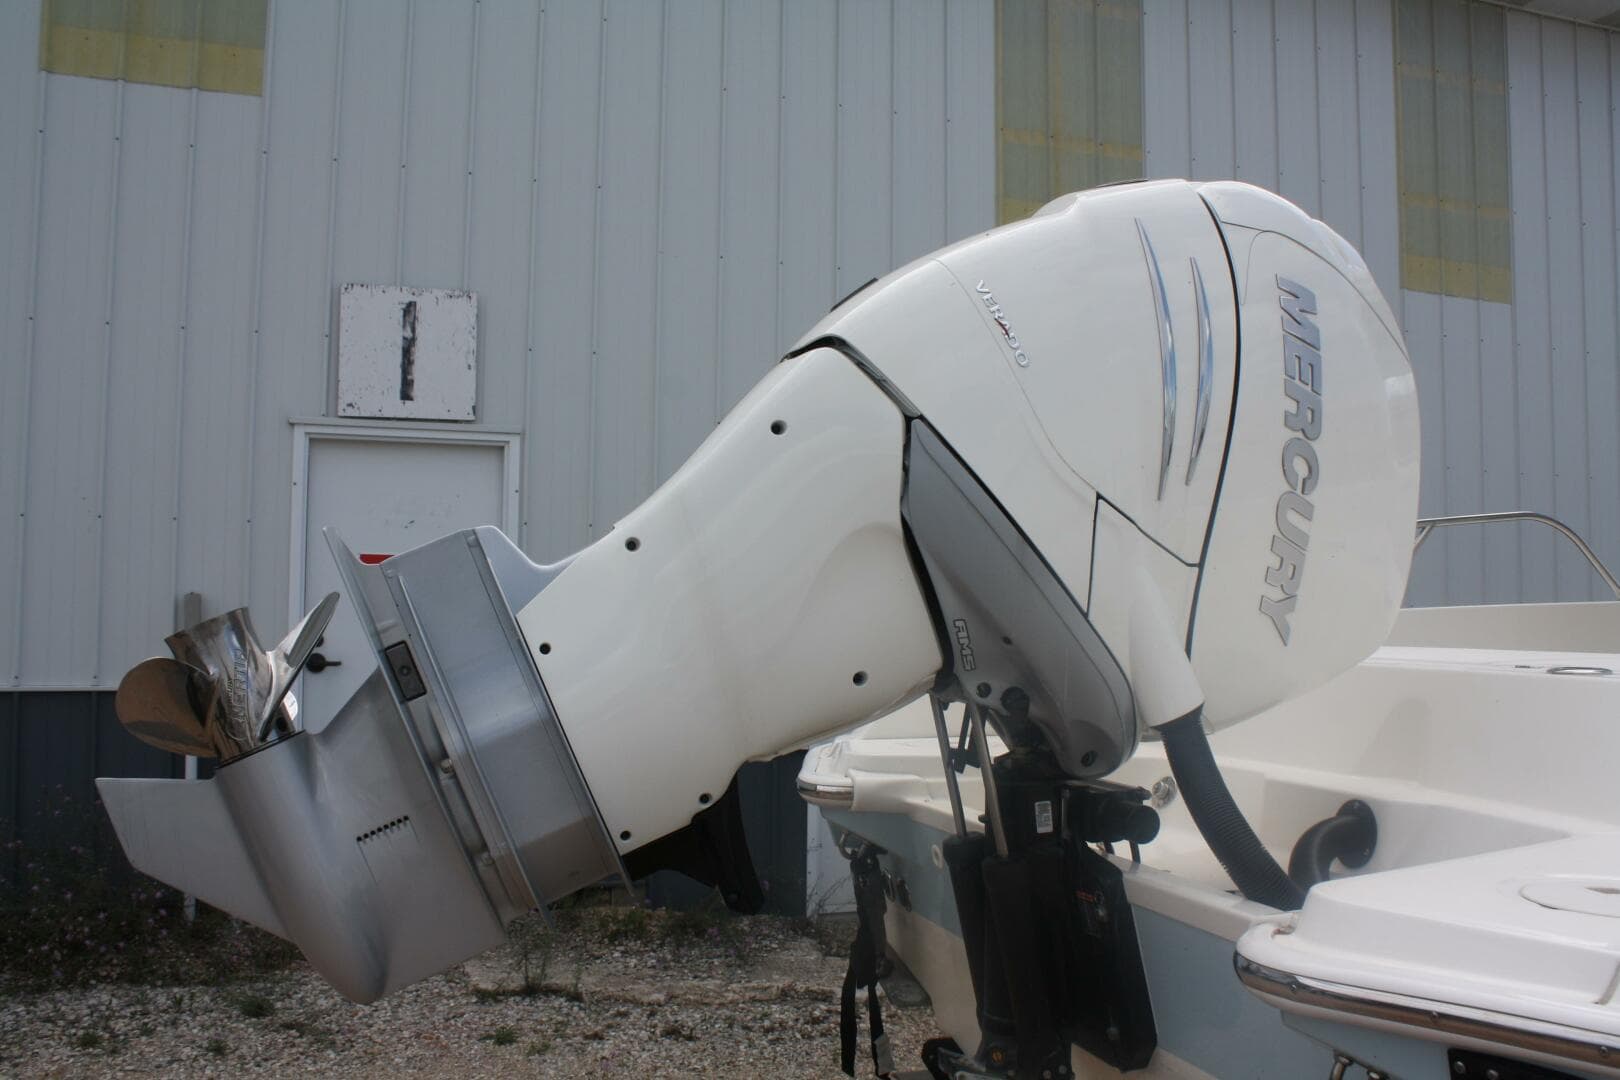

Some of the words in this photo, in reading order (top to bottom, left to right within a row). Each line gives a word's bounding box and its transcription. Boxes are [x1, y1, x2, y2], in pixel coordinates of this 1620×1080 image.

[976, 279, 1030, 368] VERADO
[1258, 273, 1322, 647] MERCURY
[953, 618, 977, 671] AMS
